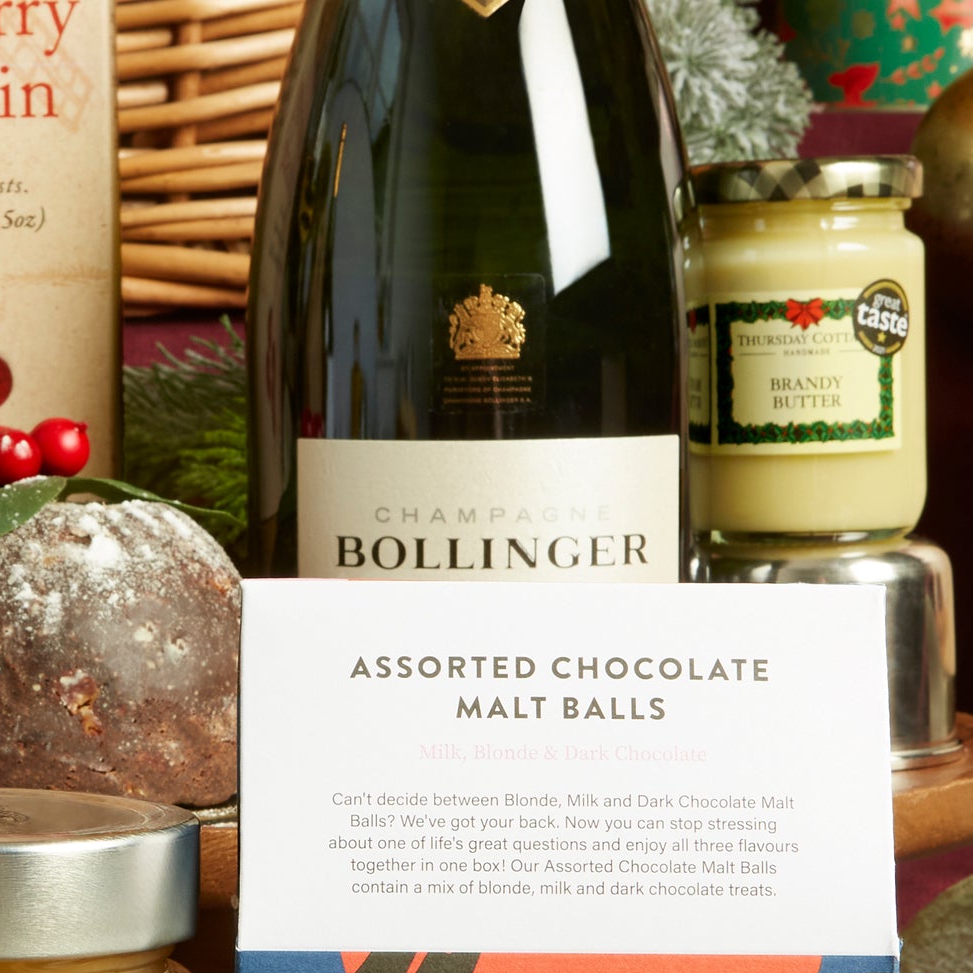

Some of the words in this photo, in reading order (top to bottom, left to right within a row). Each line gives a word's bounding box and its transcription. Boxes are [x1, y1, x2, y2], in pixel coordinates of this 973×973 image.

[872, 293, 901, 311] great
[857, 302, 908, 337] taste
[737, 332, 809, 348] THURSDAY
[771, 375, 843, 392] BRANDY
[773, 394, 842, 410] BUTTER
[374, 504, 612, 525] CHAMPAGNE
[335, 534, 649, 570] BOLLINGER
[350, 656, 535, 678] ASSORTED
[552, 657, 768, 681] CHOCOLATE
[457, 696, 546, 718] MALT
[563, 697, 665, 720] BALLS
[421, 744, 466, 763] Milk,
[475, 744, 538, 760] Blonde
[544, 746, 557, 760] &
[565, 745, 608, 760] Dark
[615, 745, 706, 761] Chocolate
[332, 792, 371, 805] Can't
[377, 793, 427, 805] decide
[434, 793, 498, 806] between
[505, 794, 561, 808] Blonde,
[568, 794, 598, 806] Milk
[604, 794, 631, 807] and
[638, 795, 673, 807] Dark
[679, 795, 755, 808] Chocolate
[762, 796, 793, 809] Malt
[351, 814, 395, 827] Balls?
[400, 815, 445, 827] We've
[451, 816, 475, 831] got
[481, 819, 514, 831] your
[520, 815, 559, 828] back.
[566, 816, 599, 828] Now
[605, 820, 631, 832] you
[638, 820, 664, 829] can
[671, 818, 702, 832] stop
[708, 818, 776, 833] stressing
[329, 836, 372, 849] about
[378, 840, 405, 849] one
[411, 836, 425, 849] of
[431, 836, 463, 849] life's
[469, 838, 507, 853] great
[513, 838, 586, 853] questions
[592, 838, 620, 851] and
[626, 838, 666, 854] enjoy
[673, 839, 688, 851] all
[695, 839, 733, 852] three
[739, 839, 798, 852] flavours
[351, 858, 416, 874] together
[422, 858, 433, 871] in
[440, 862, 467, 871] one
[474, 859, 504, 872] box!
[511, 859, 539, 872] Our
[545, 860, 612, 872] Assorted
[619, 860, 696, 873] Chocolate
[703, 861, 735, 873] Malt
[741, 861, 776, 874] Balls
[352, 880, 408, 893] contain
[414, 884, 421, 893] a
[428, 881, 454, 893] mix
[459, 880, 474, 894] of
[479, 881, 534, 896] blonde,
[541, 881, 571, 894] milk
[577, 882, 604, 895] and
[611, 882, 644, 895] dark
[649, 882, 723, 896] chocolate
[729, 884, 776, 896] treats.
